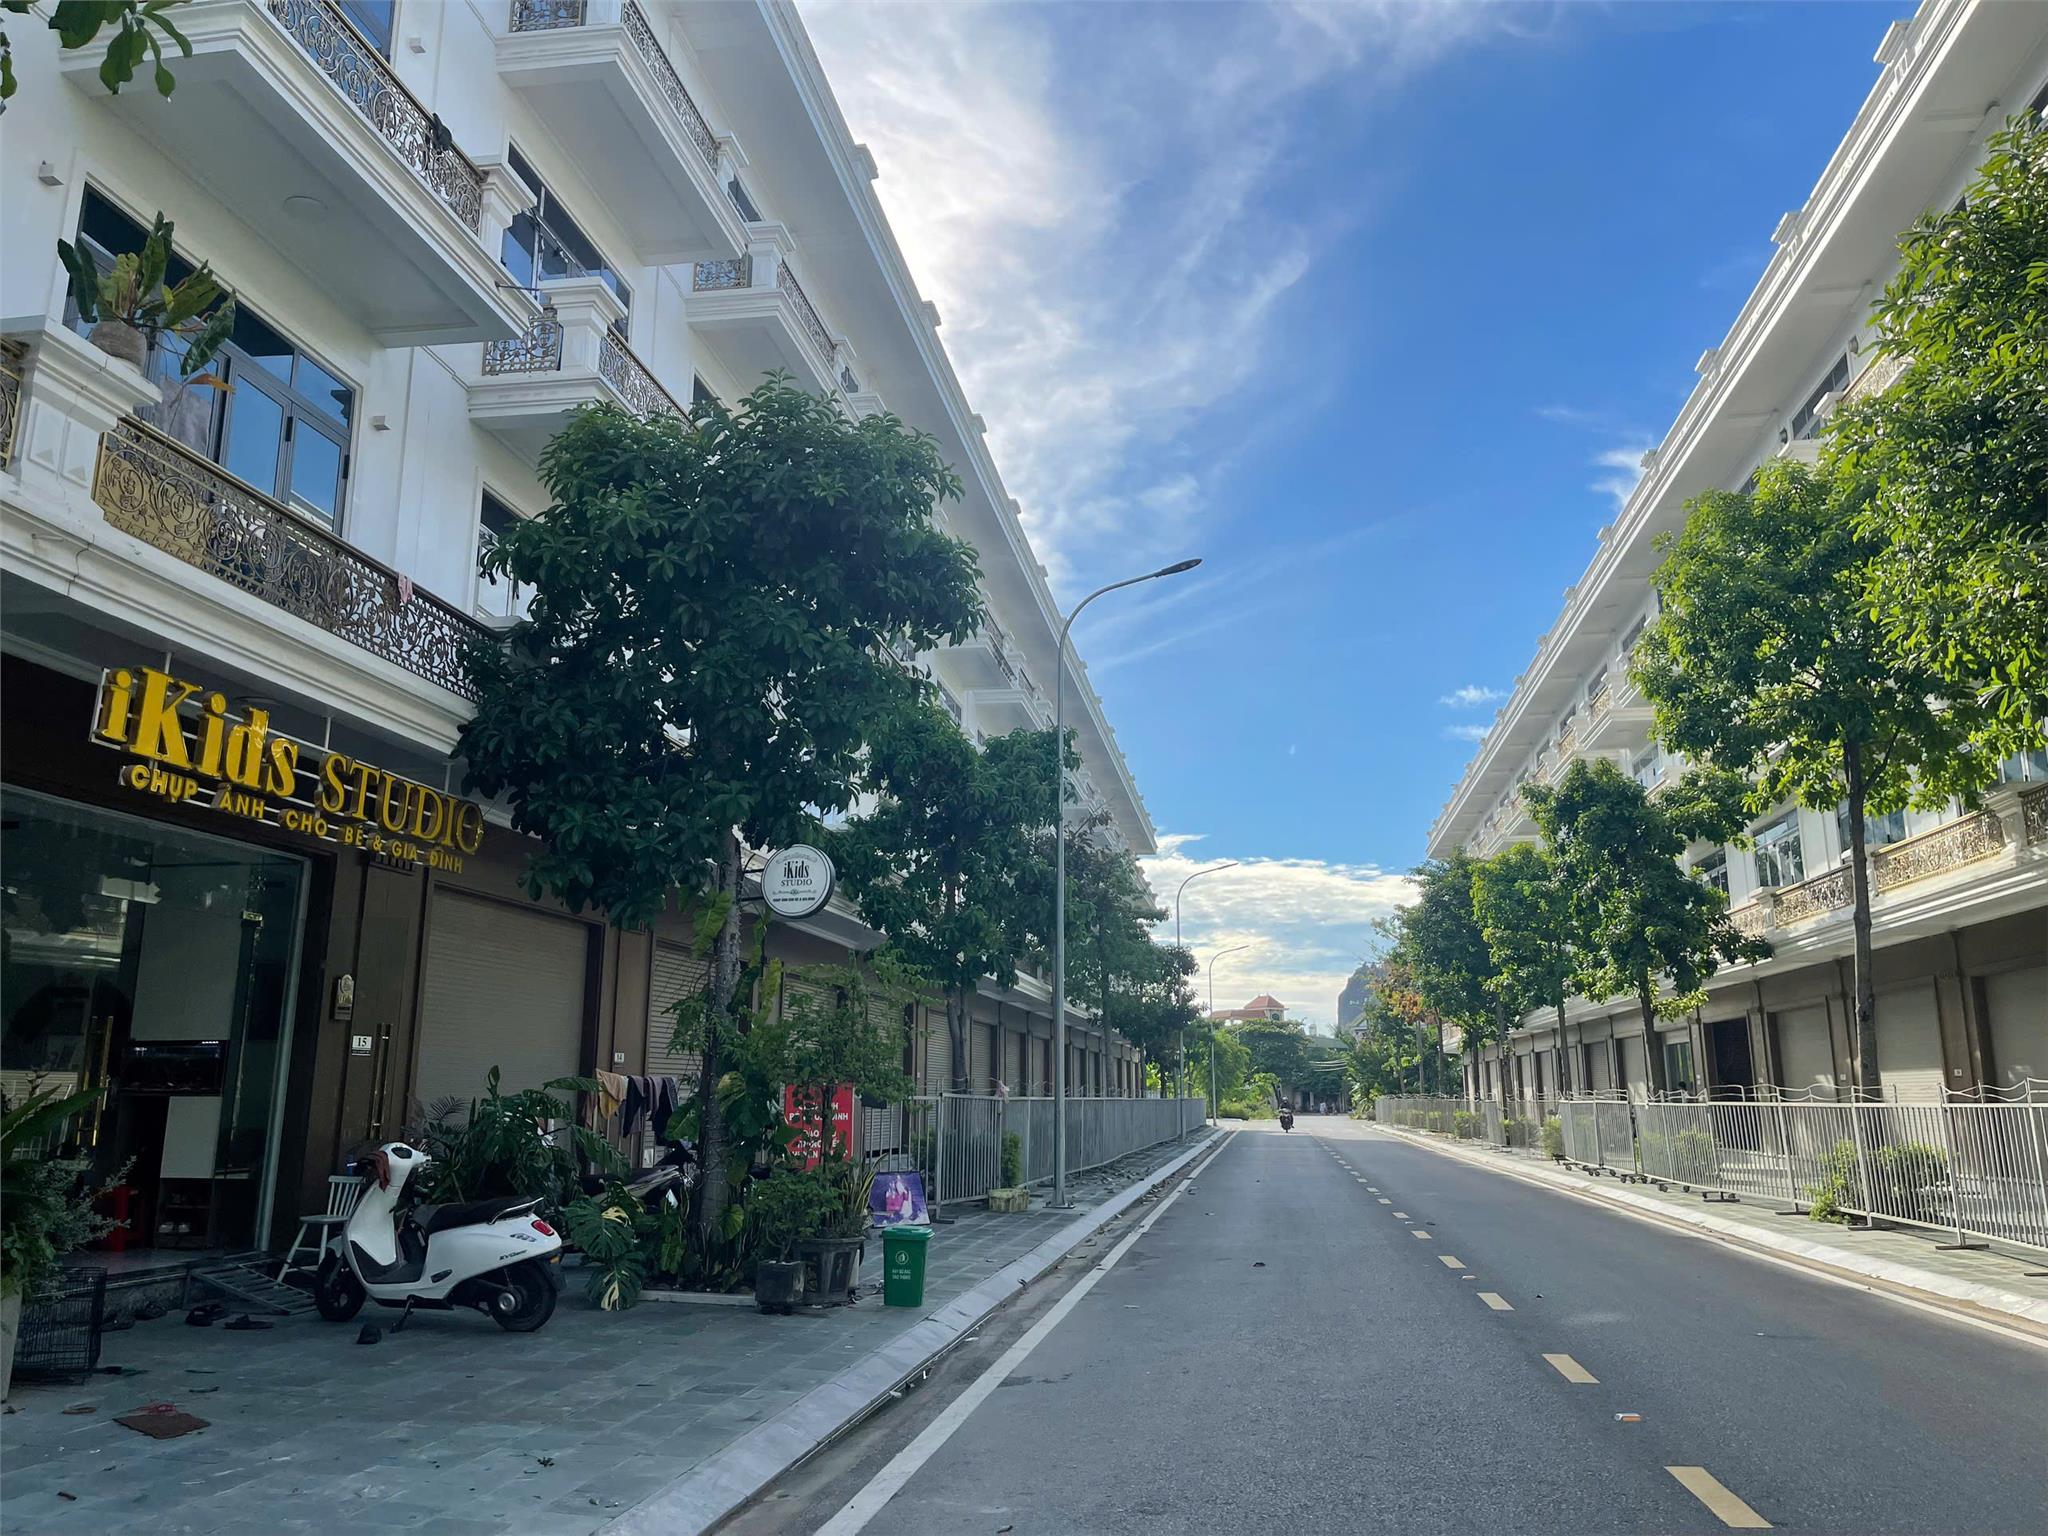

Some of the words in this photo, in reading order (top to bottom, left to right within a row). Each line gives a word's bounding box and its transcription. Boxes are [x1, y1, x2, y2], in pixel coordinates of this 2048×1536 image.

[102, 666, 298, 797] iKids
[322, 754, 484, 855] STUDIO
[131, 765, 199, 803] CHỤP
[285, 810, 328, 838] CHO
[372, 835, 382, 851] &
[392, 841, 417, 861] GIA
[784, 861, 809, 879] iKids
[781, 879, 812, 887] STUDIO
[358, 1037, 367, 1047] 15
